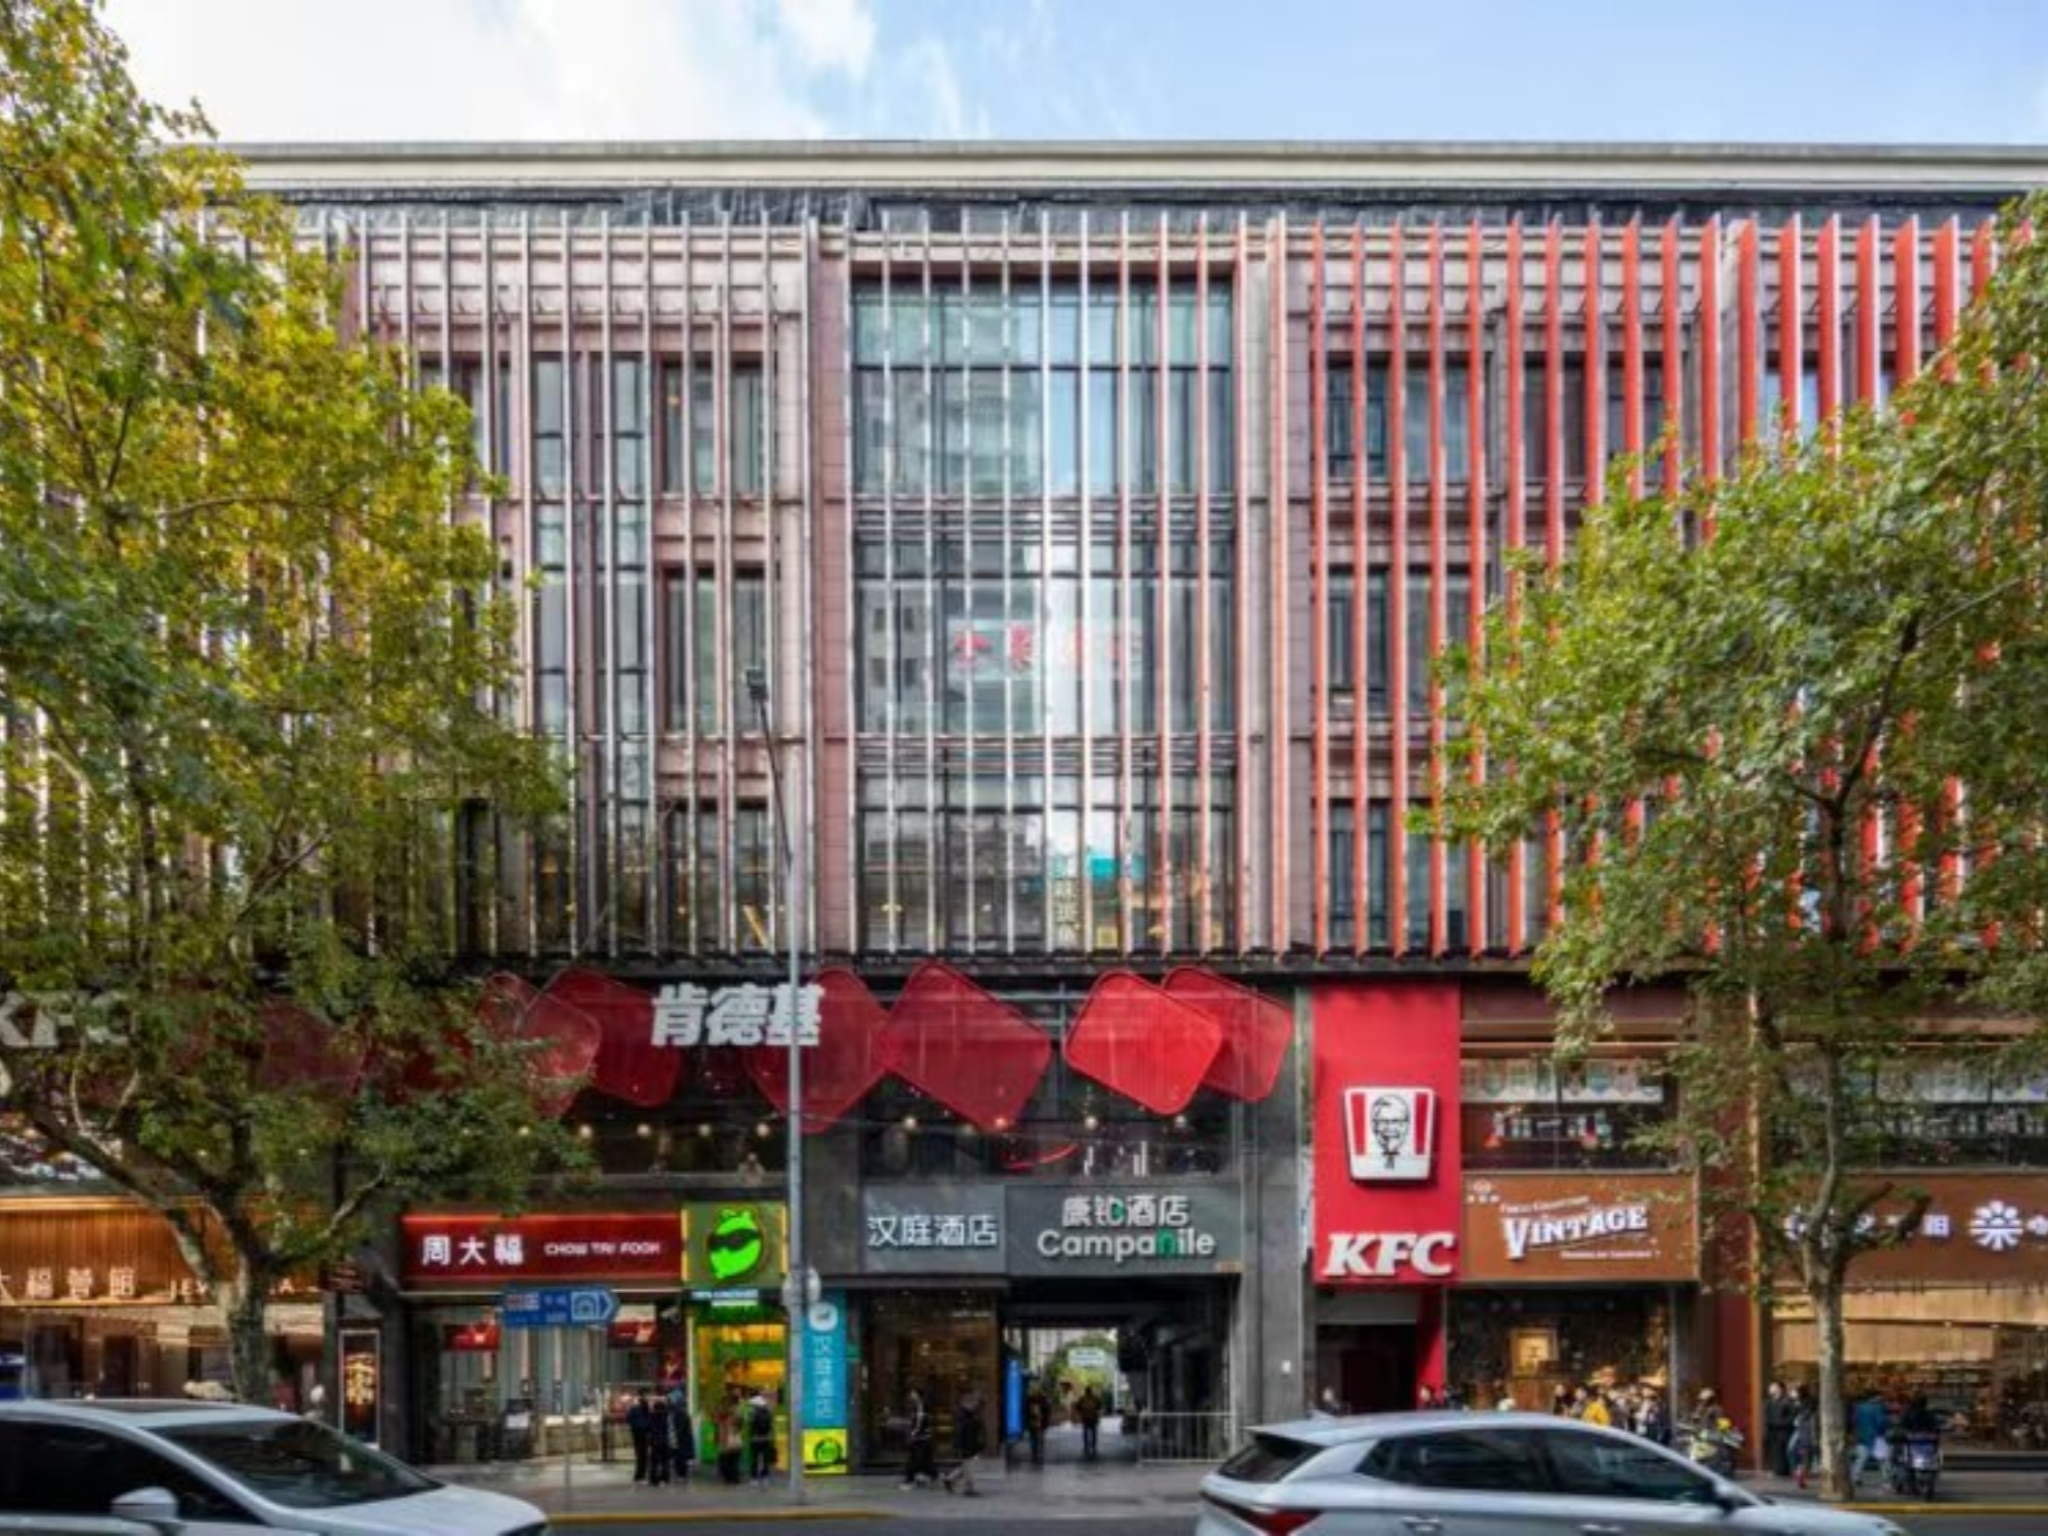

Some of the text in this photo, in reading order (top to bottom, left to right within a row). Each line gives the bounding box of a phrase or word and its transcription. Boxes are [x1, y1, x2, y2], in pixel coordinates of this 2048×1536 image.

[651, 982, 825, 1047] 肯德基
[867, 1214, 998, 1247] 汉庭酒店
[1037, 1229, 1216, 1263] Campanile
[422, 1234, 523, 1265] 周大福
[545, 1243, 588, 1256] CHOW
[620, 1242, 661, 1255] FOOK
[1323, 1233, 1457, 1276] KFC
